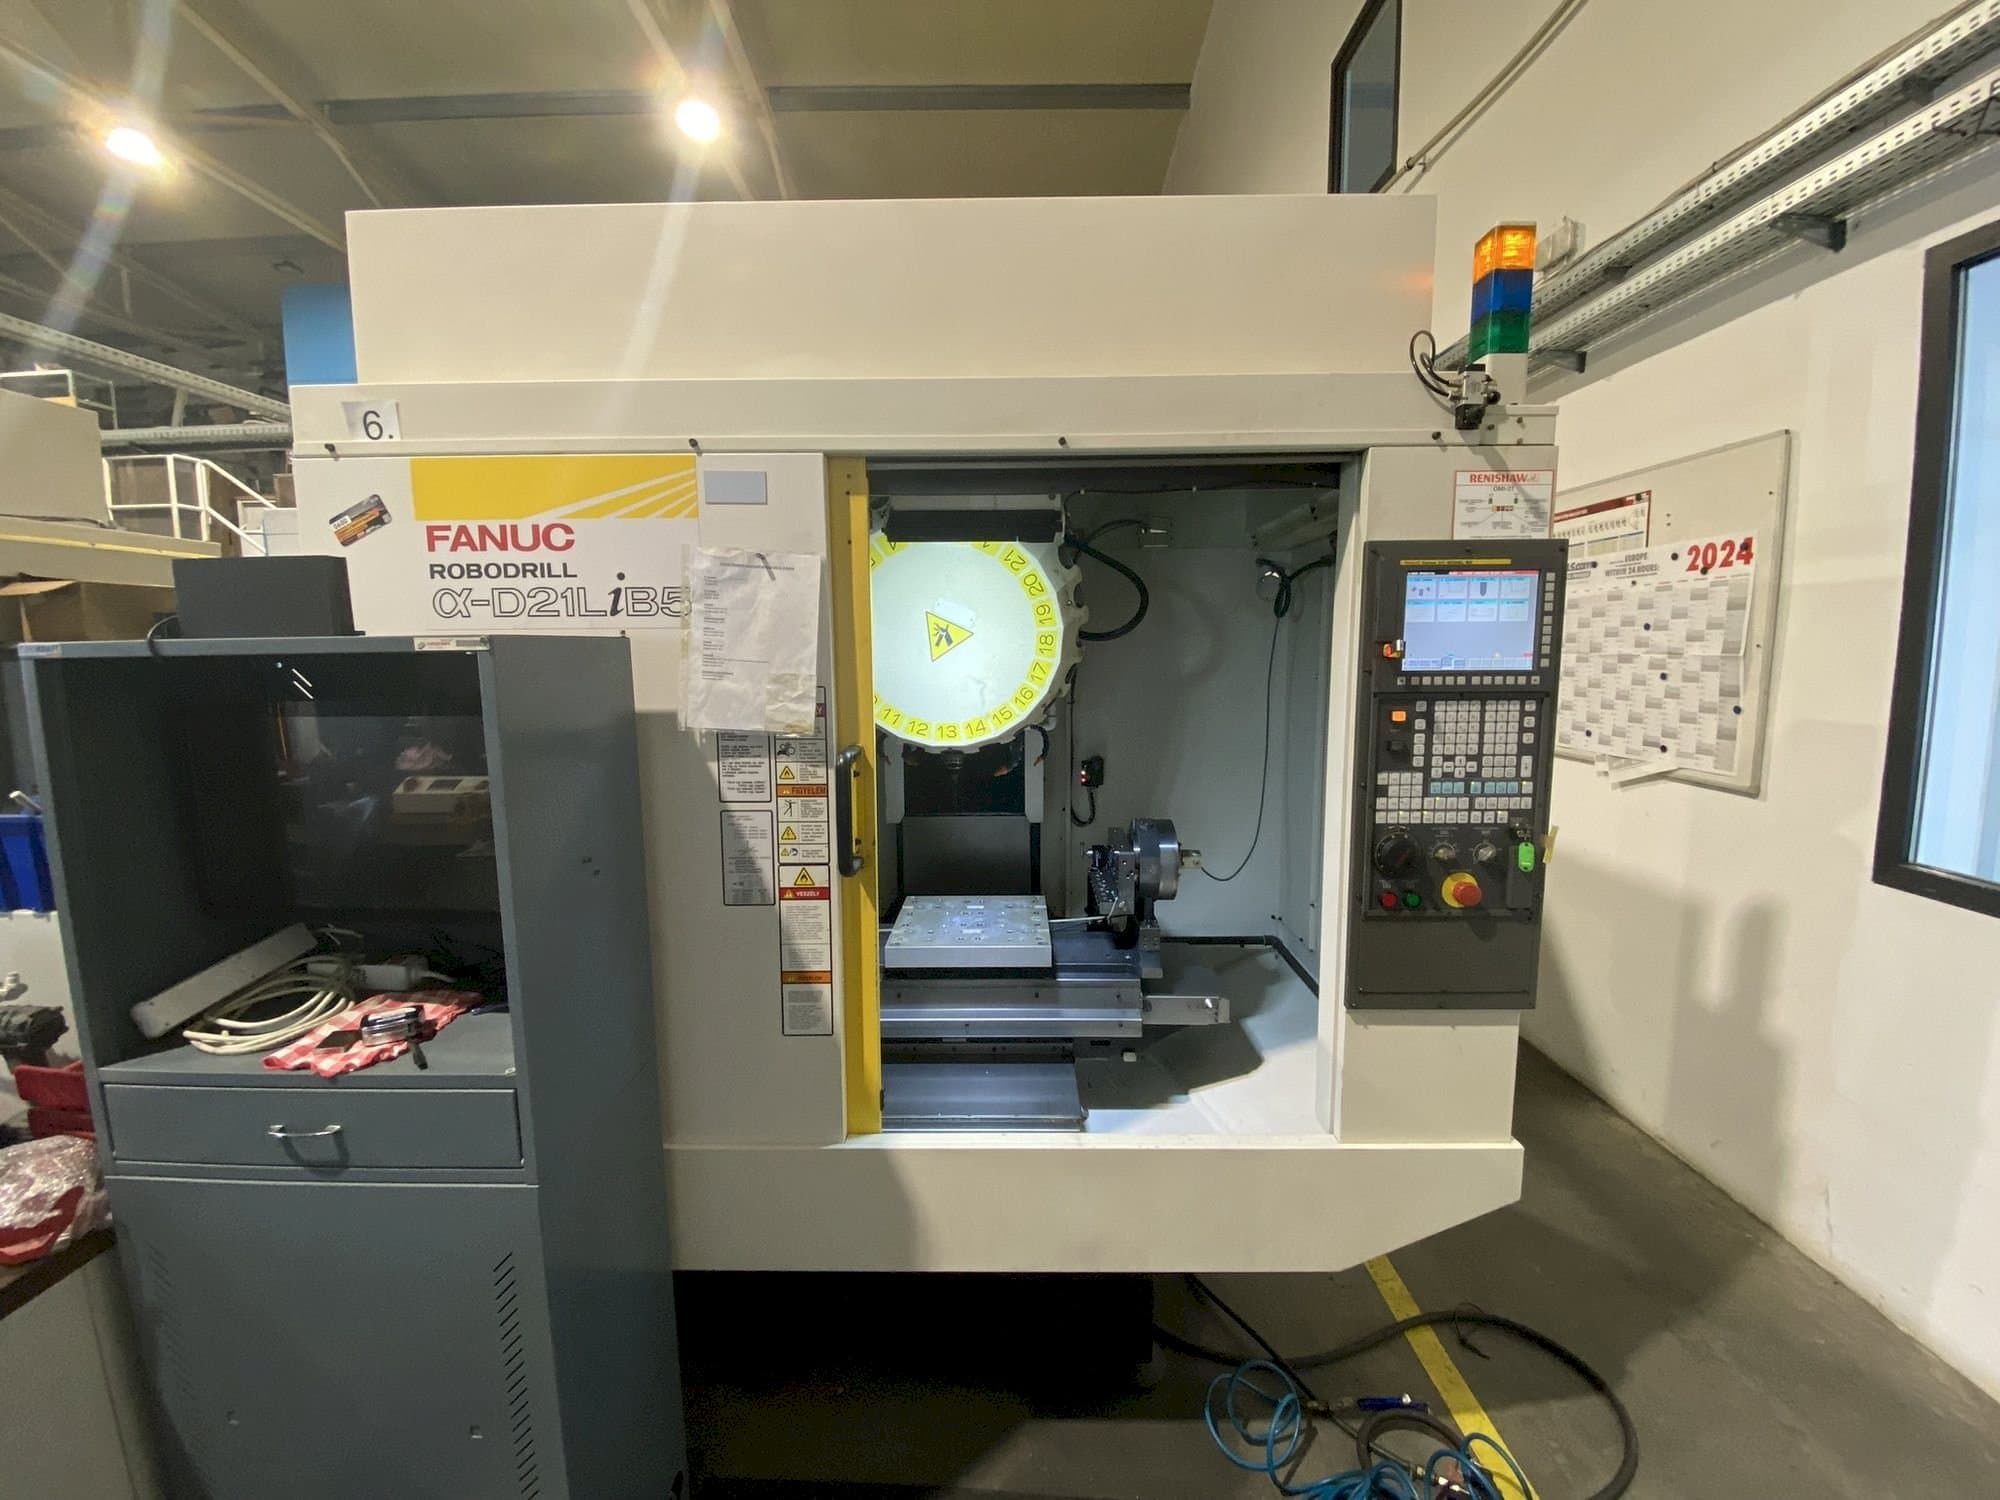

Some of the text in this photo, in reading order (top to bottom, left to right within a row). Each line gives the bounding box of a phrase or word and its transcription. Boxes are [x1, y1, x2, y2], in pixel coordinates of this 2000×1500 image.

[362, 410, 394, 440] 6.
[1470, 473, 1527, 483] RENISHAW
[425, 522, 576, 552] FANUC
[1004, 550, 1026, 571] 21
[1686, 537, 1754, 572] 2024
[429, 562, 578, 580] ROBODRILL
[1023, 573, 1045, 596] 20
[1036, 604, 1053, 625] 19
[1039, 634, 1054, 654] 18
[1030, 662, 1047, 682] 17
[1014, 686, 1034, 706] 16
[882, 708, 902, 725] 11
[992, 706, 1014, 724] 15
[908, 720, 929, 736] 12
[937, 725, 958, 739] 13
[966, 720, 987, 736] 14
